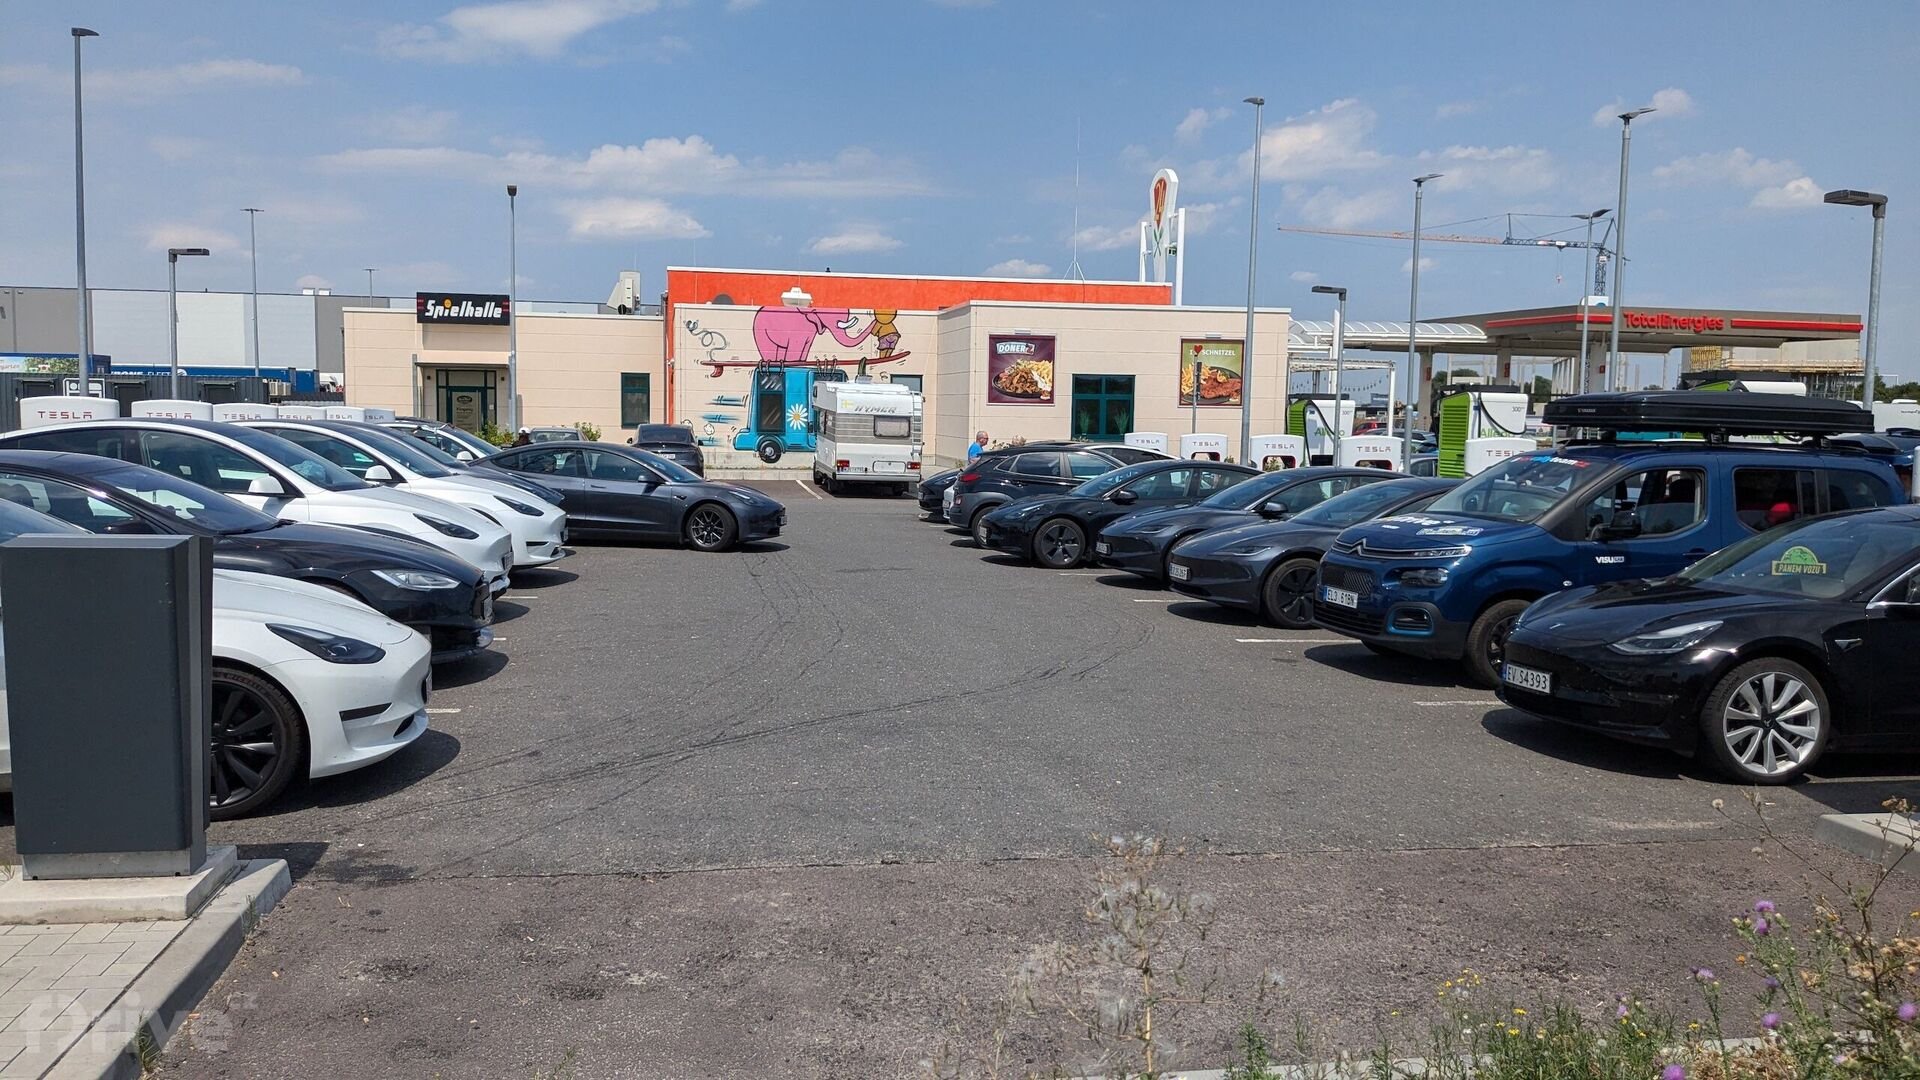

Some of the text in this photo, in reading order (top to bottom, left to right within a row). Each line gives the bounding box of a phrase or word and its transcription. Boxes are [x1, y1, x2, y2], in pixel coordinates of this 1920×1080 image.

[425, 300, 502, 318] Spielhalle
[1623, 311, 1724, 333] TotalEnergies
[37, 410, 93, 420] TESLA
[1507, 666, 1517, 682] EV
